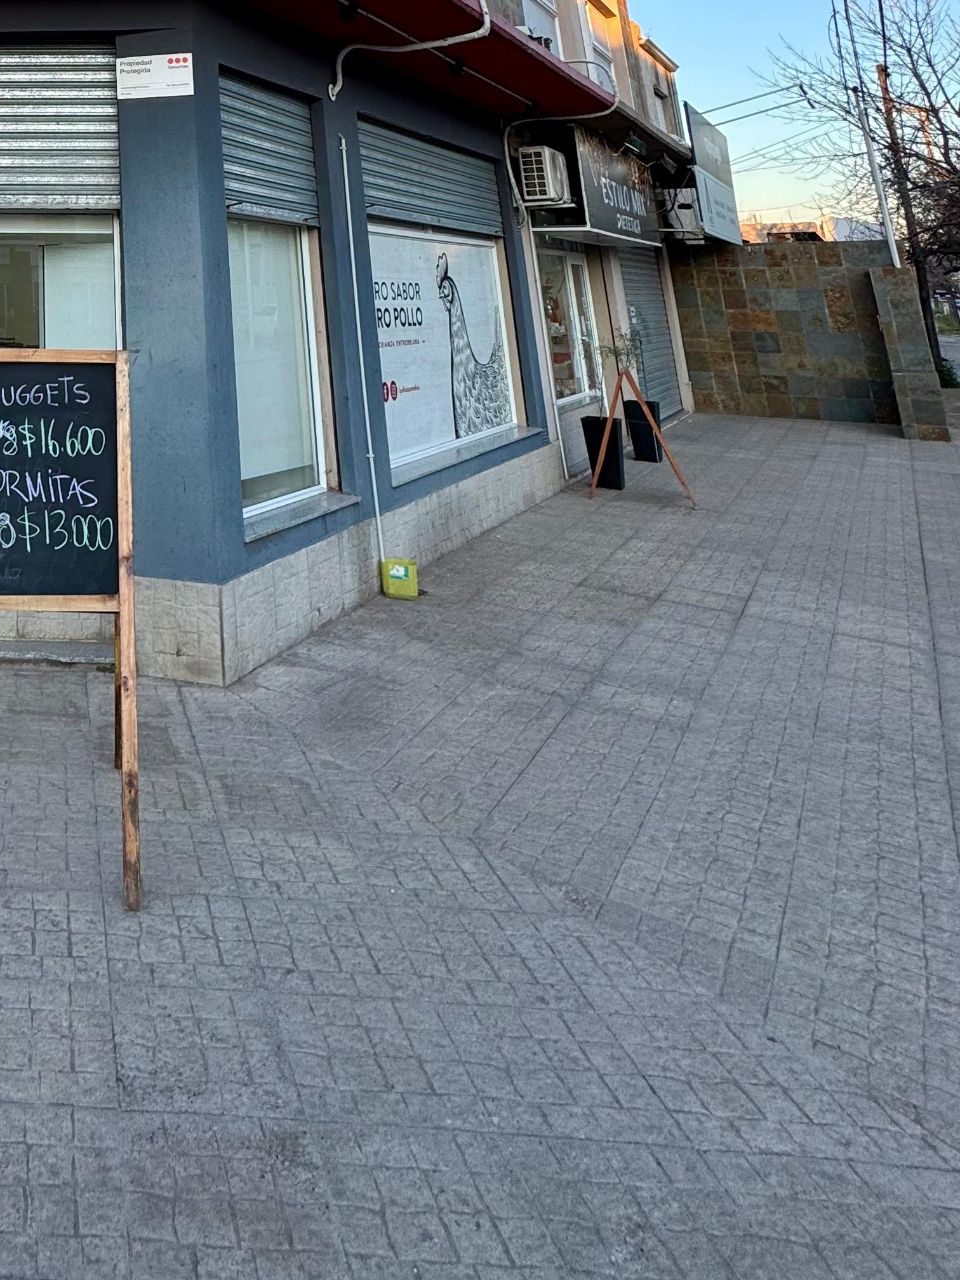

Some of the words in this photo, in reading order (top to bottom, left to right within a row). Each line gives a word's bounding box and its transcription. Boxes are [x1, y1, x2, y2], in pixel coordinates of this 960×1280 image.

[119, 59, 152, 67] Propiedad
[600, 176, 630, 212] ESTILO
[374, 281, 388, 300] RO
[390, 281, 421, 300] SABOR
[376, 307, 391, 329] RO
[393, 306, 423, 328] POLLO
